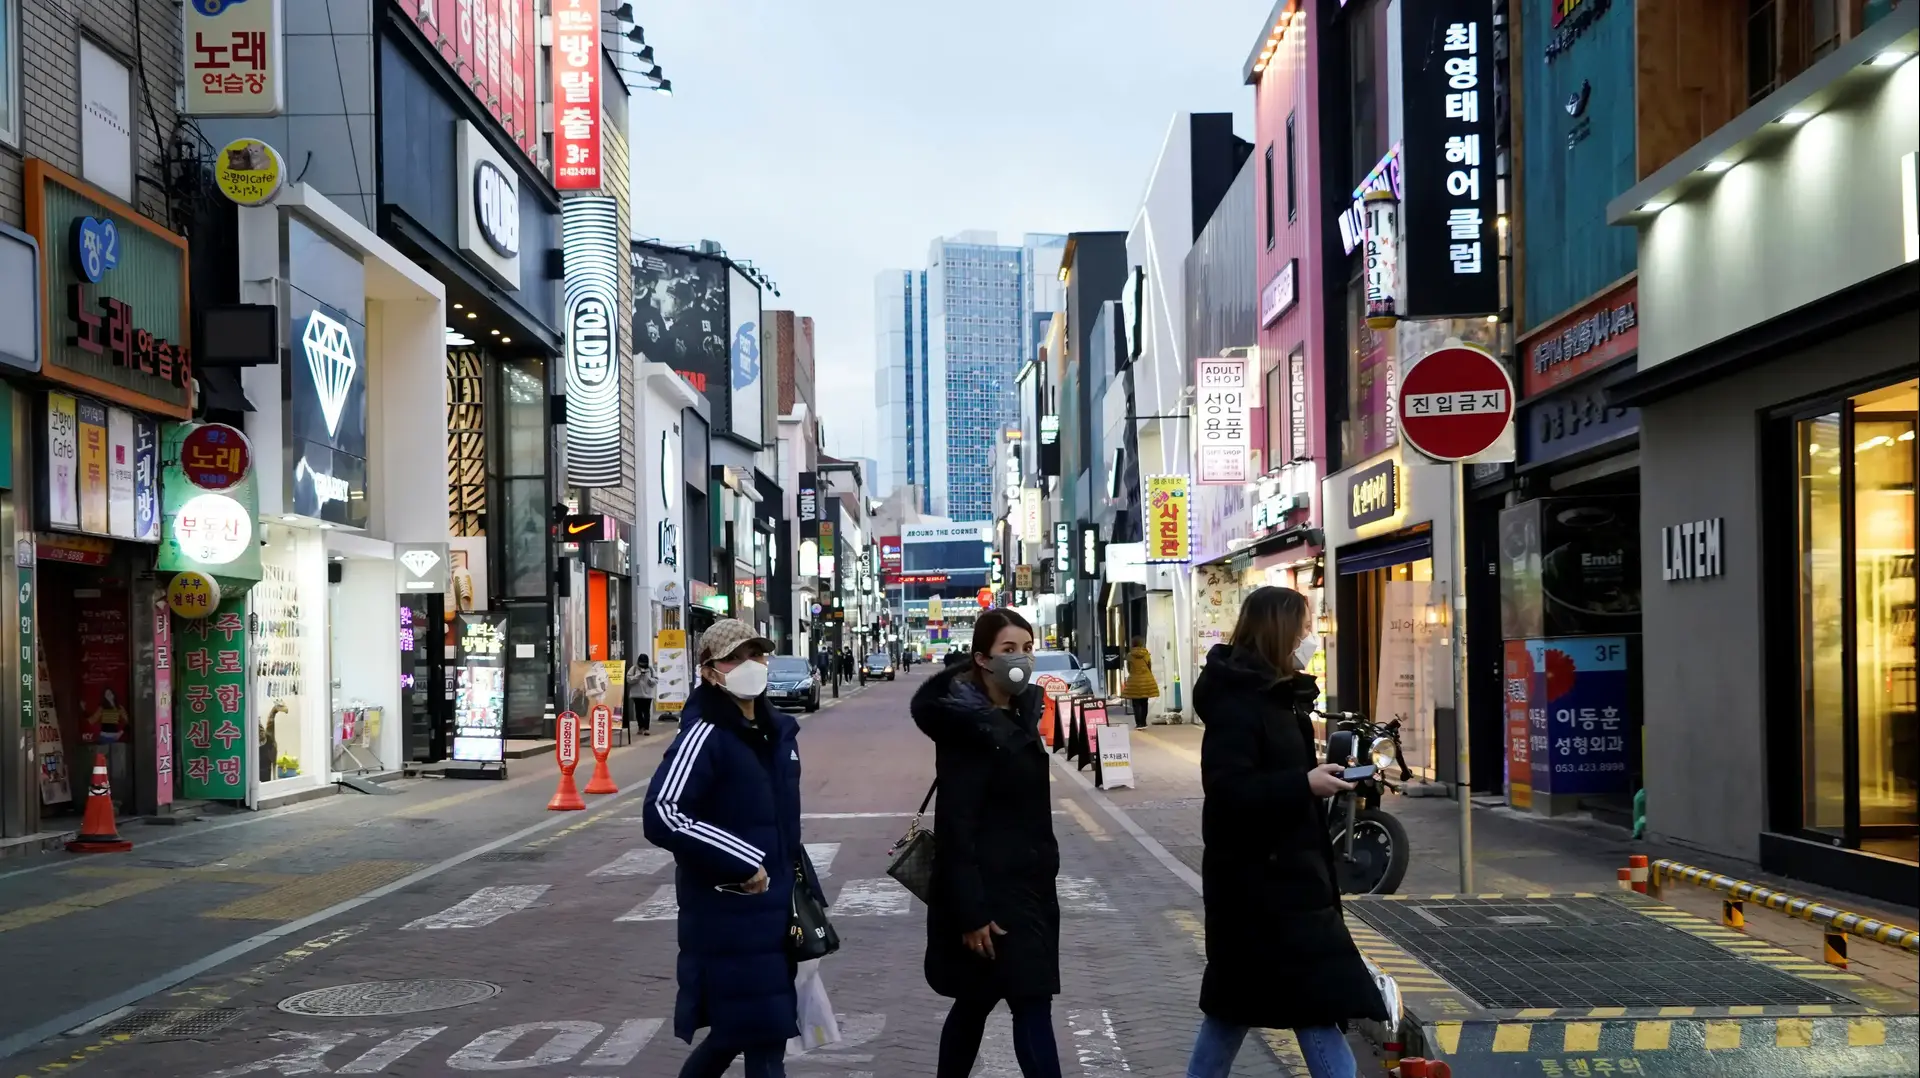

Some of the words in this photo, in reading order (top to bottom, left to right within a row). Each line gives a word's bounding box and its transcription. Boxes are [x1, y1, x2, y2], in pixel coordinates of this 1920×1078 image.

[194, 31, 266, 70] 노래
[203, 73, 266, 94] 연습장
[1443, 22, 1478, 123] 최영태
[560, 35, 594, 140] 방탈출
[566, 144, 589, 164] 3F
[1444, 133, 1480, 200] 헤어
[1446, 208, 1483, 274] 클럽
[576, 302, 607, 385] FOLDER
[1205, 366, 1241, 375] ADULT
[1205, 392, 1242, 414] 성인
[1411, 392, 1500, 415] 진입금지
[51, 402, 75, 436] 고양이
[1204, 417, 1244, 440] 용품
[137, 423, 154, 522] 노래방
[189, 445, 241, 474] 노래
[801, 495, 815, 521] NBA
[181, 516, 240, 541] 부동산
[906, 528, 934, 537] AROUND
[936, 528, 949, 536] THE
[951, 527, 978, 536] CORNER
[1160, 503, 1180, 556] 사진관
[1661, 517, 1722, 581] LATEM
[180, 578, 202, 590] 부부
[173, 592, 208, 607] 철학원
[21, 615, 32, 717] 한미약국
[186, 648, 243, 678] 타로
[1595, 645, 1621, 662] 3F
[185, 684, 243, 714] 궁합
[1556, 706, 1621, 731] 이동훈
[186, 720, 242, 750] 신수
[563, 721, 572, 757] 강화유리
[1555, 735, 1624, 756] 성형외과
[186, 755, 243, 786] 작명
[1102, 753, 1129, 761] 주차금지
[1541, 1057, 1645, 1078] 통행주의
